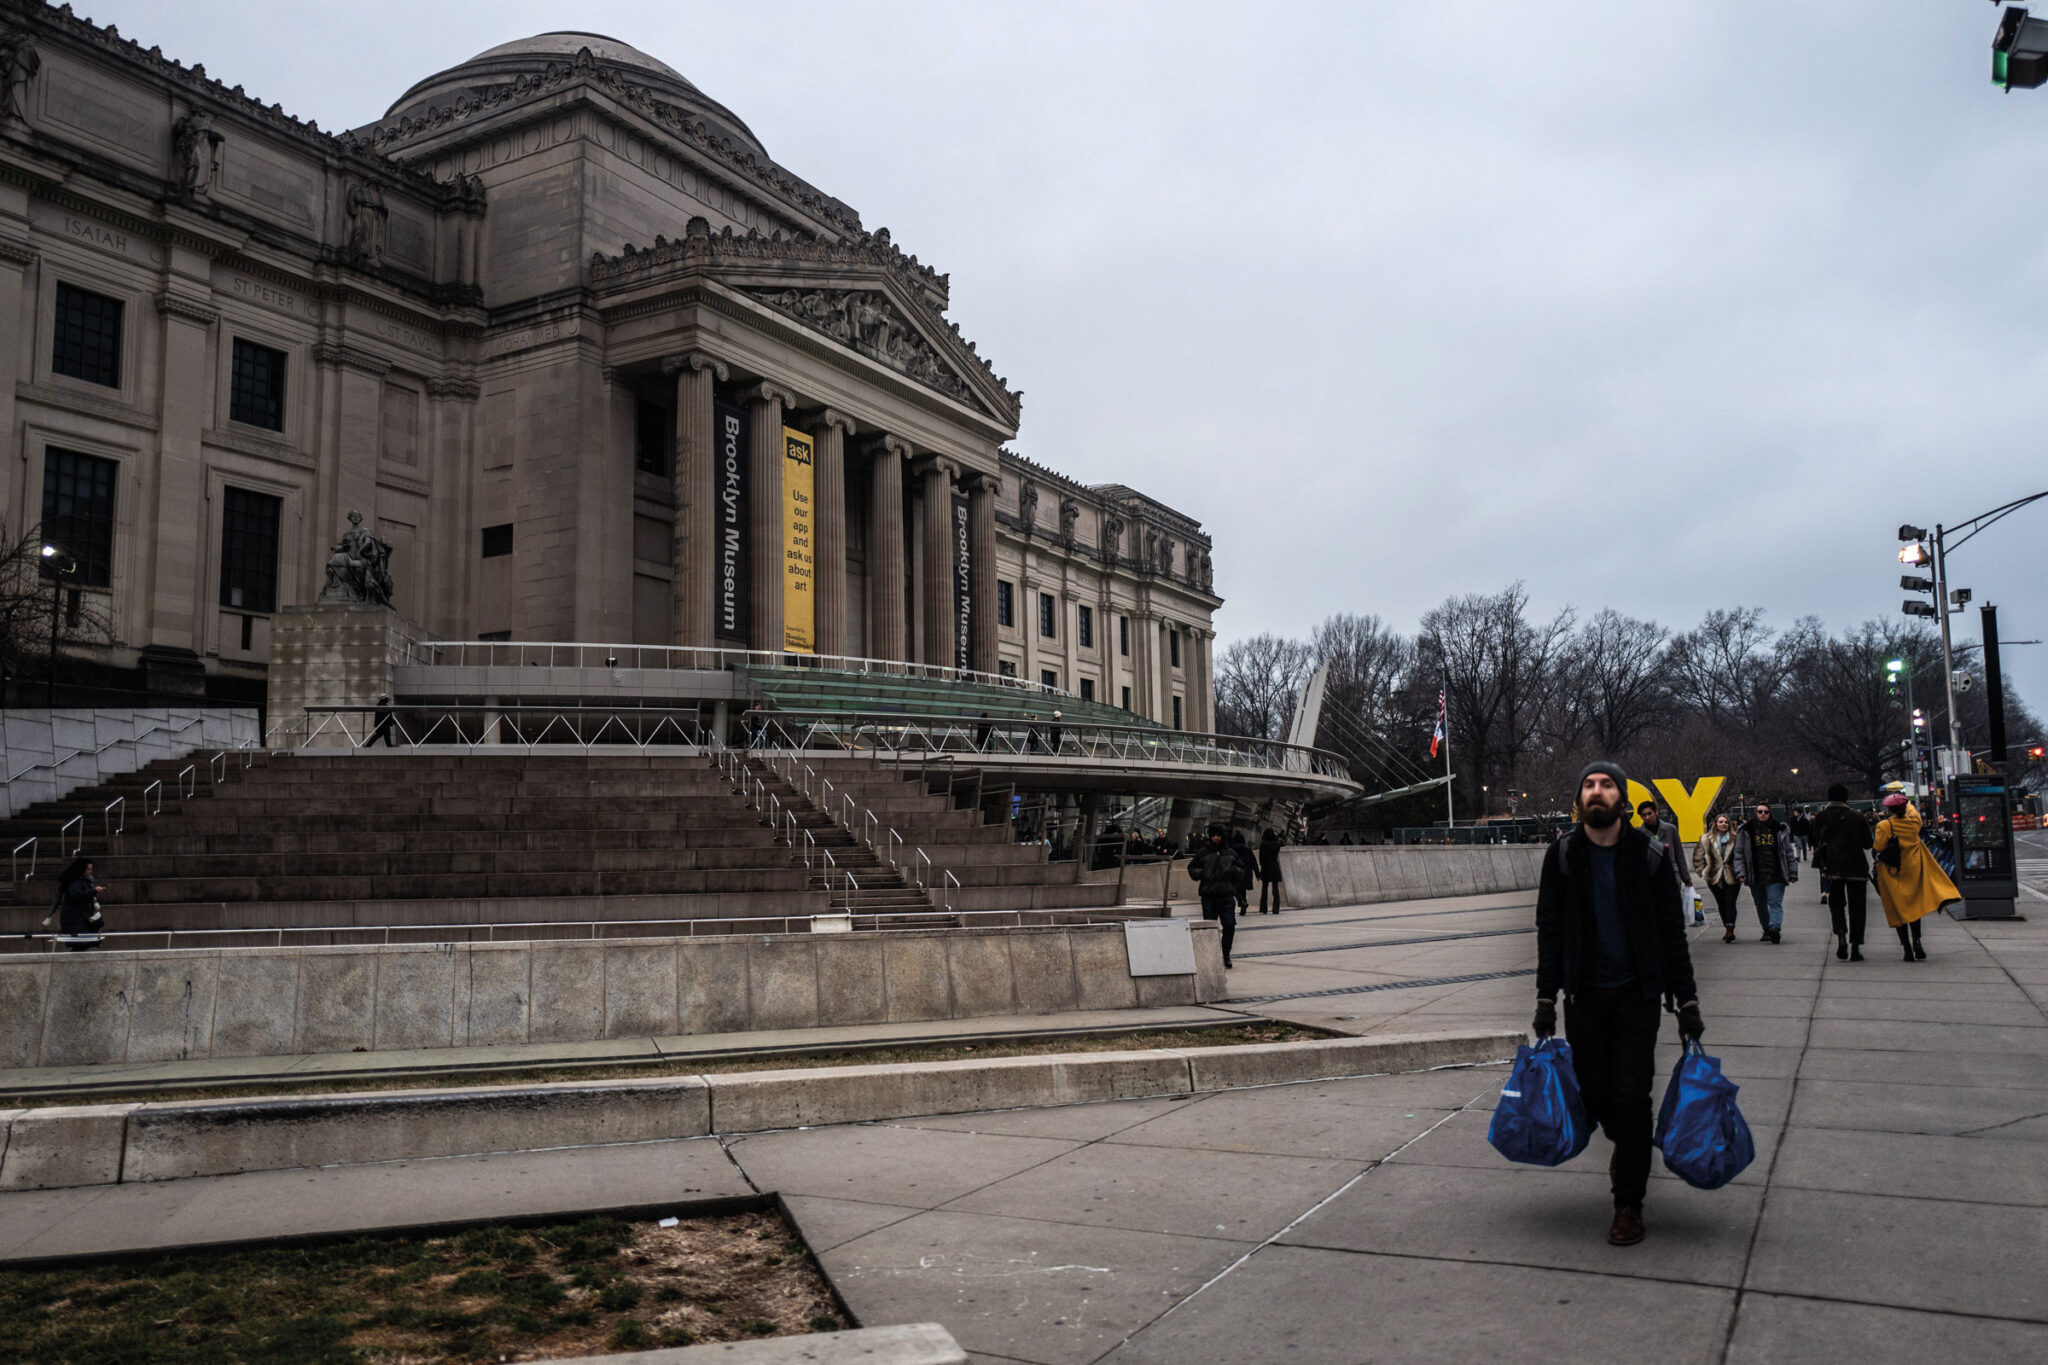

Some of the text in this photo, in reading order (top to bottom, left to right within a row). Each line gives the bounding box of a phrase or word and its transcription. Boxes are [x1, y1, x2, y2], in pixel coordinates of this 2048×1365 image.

[64, 216, 127, 252] ISAIAH
[254, 283, 295, 310] PETER
[496, 326, 560, 354] MOHAMMED
[789, 444, 809, 463] ask
[793, 489, 808, 504] Use
[794, 507, 808, 518] our
[723, 415, 740, 630] Brooklyn Museum
[793, 522, 808, 534] app
[793, 536, 808, 548] and
[958, 505, 970, 591] Brooklyn
[787, 550, 812, 565] ask us
[788, 563, 812, 578] about
[795, 581, 807, 592] art
